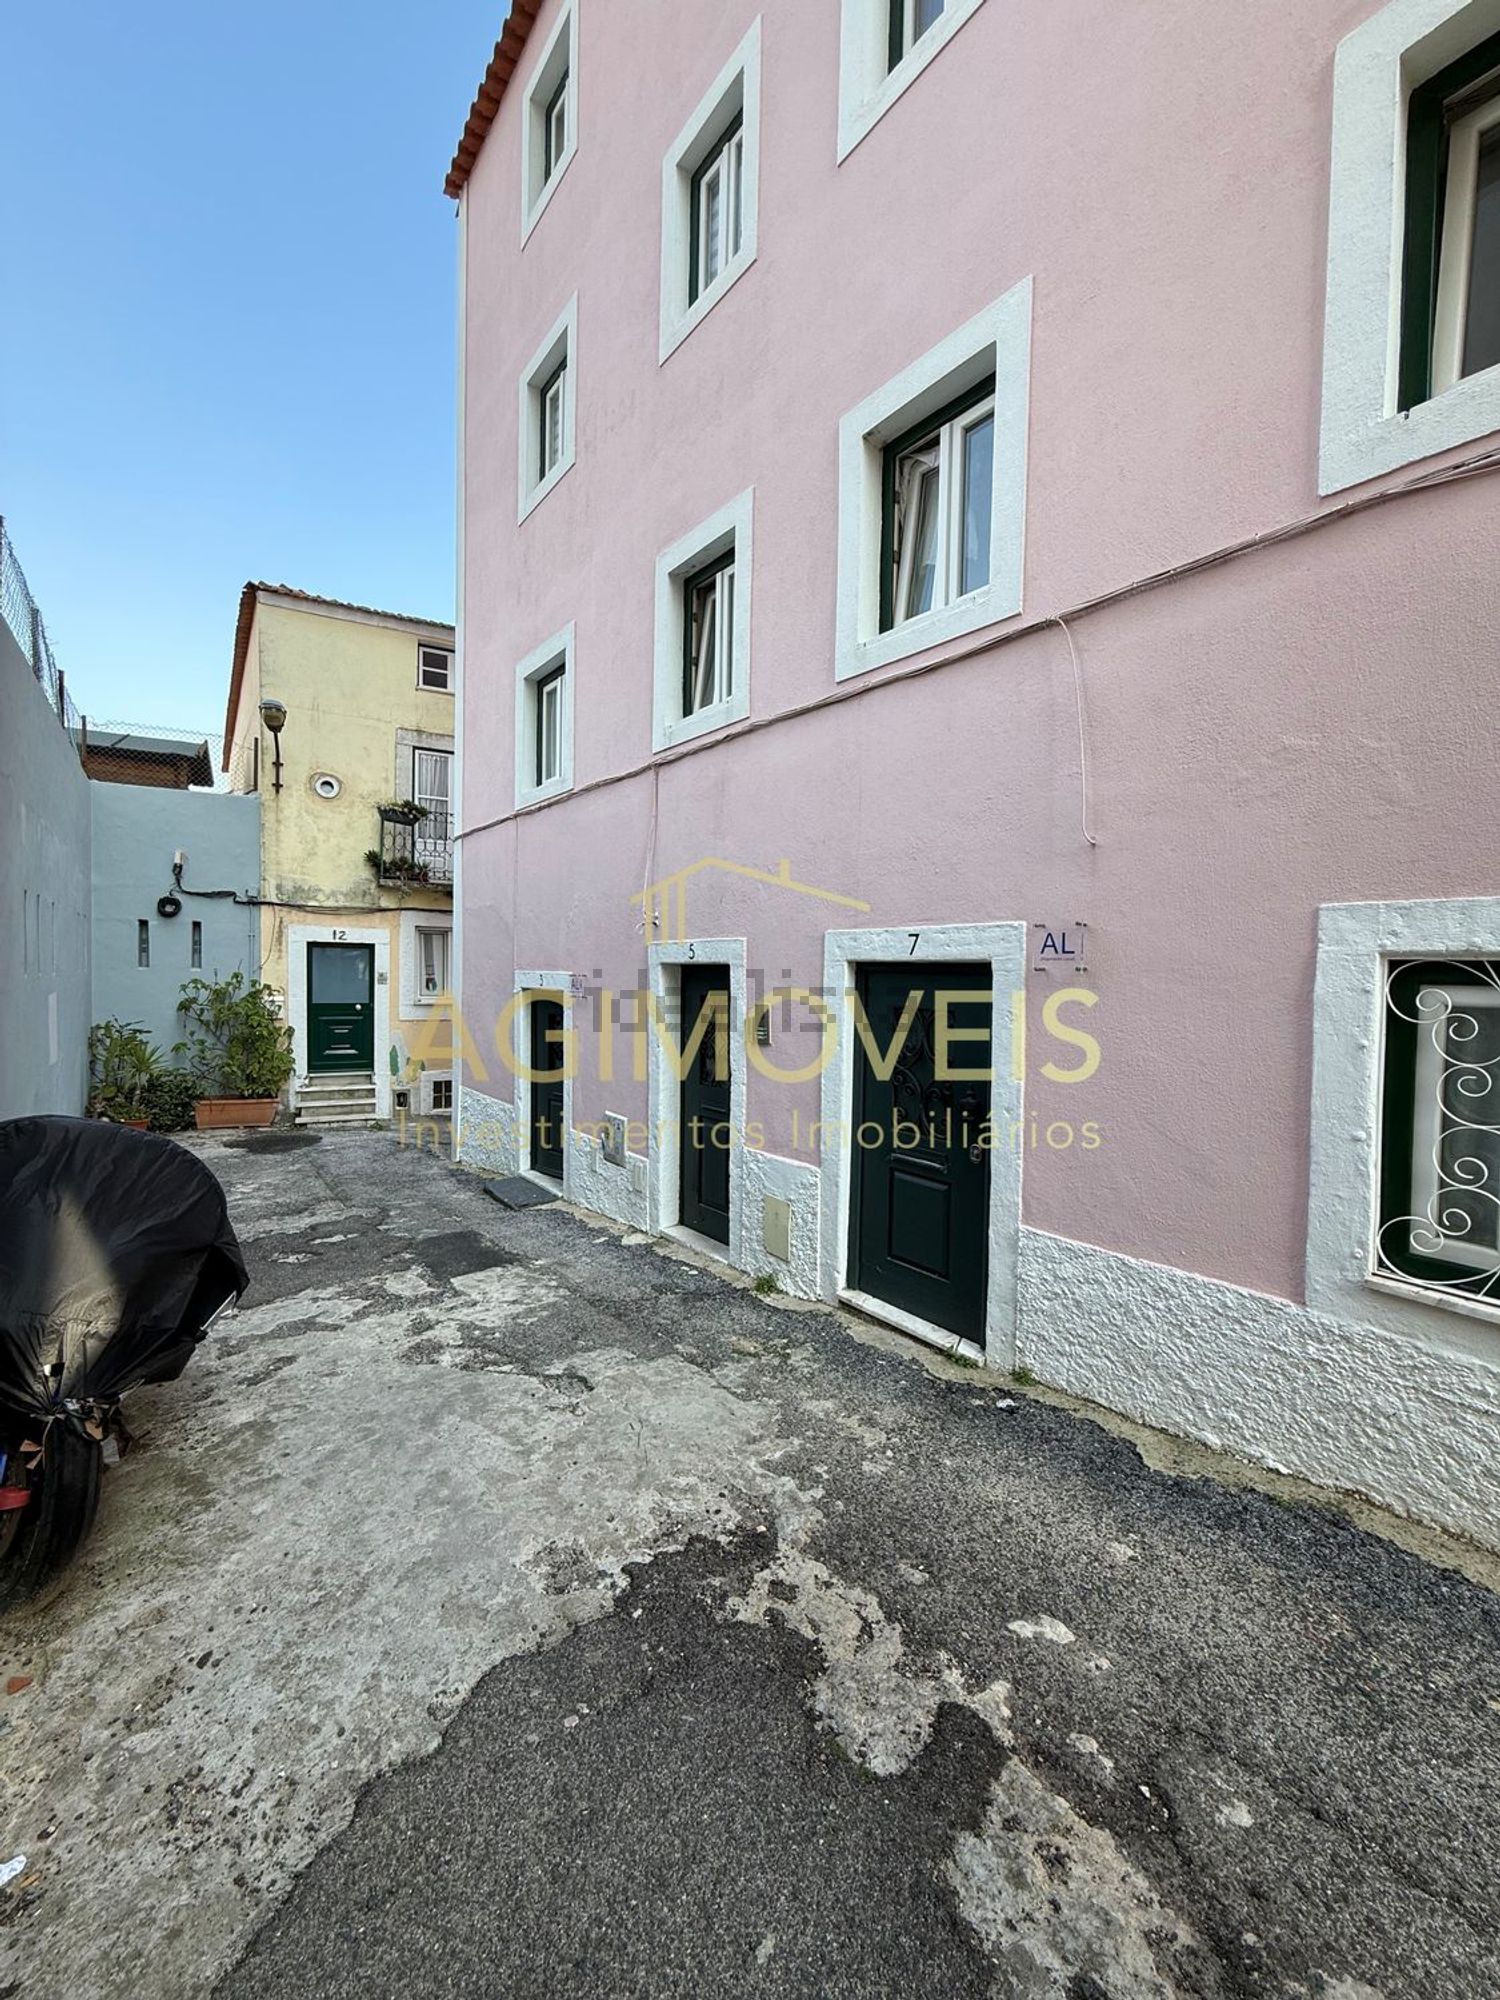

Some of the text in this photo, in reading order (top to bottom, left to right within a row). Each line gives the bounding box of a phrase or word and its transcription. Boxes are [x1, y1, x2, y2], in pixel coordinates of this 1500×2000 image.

[332, 929, 348, 941] 12
[908, 933, 920, 956] 7
[1040, 932, 1075, 954] AL
[688, 943, 696, 960] 5
